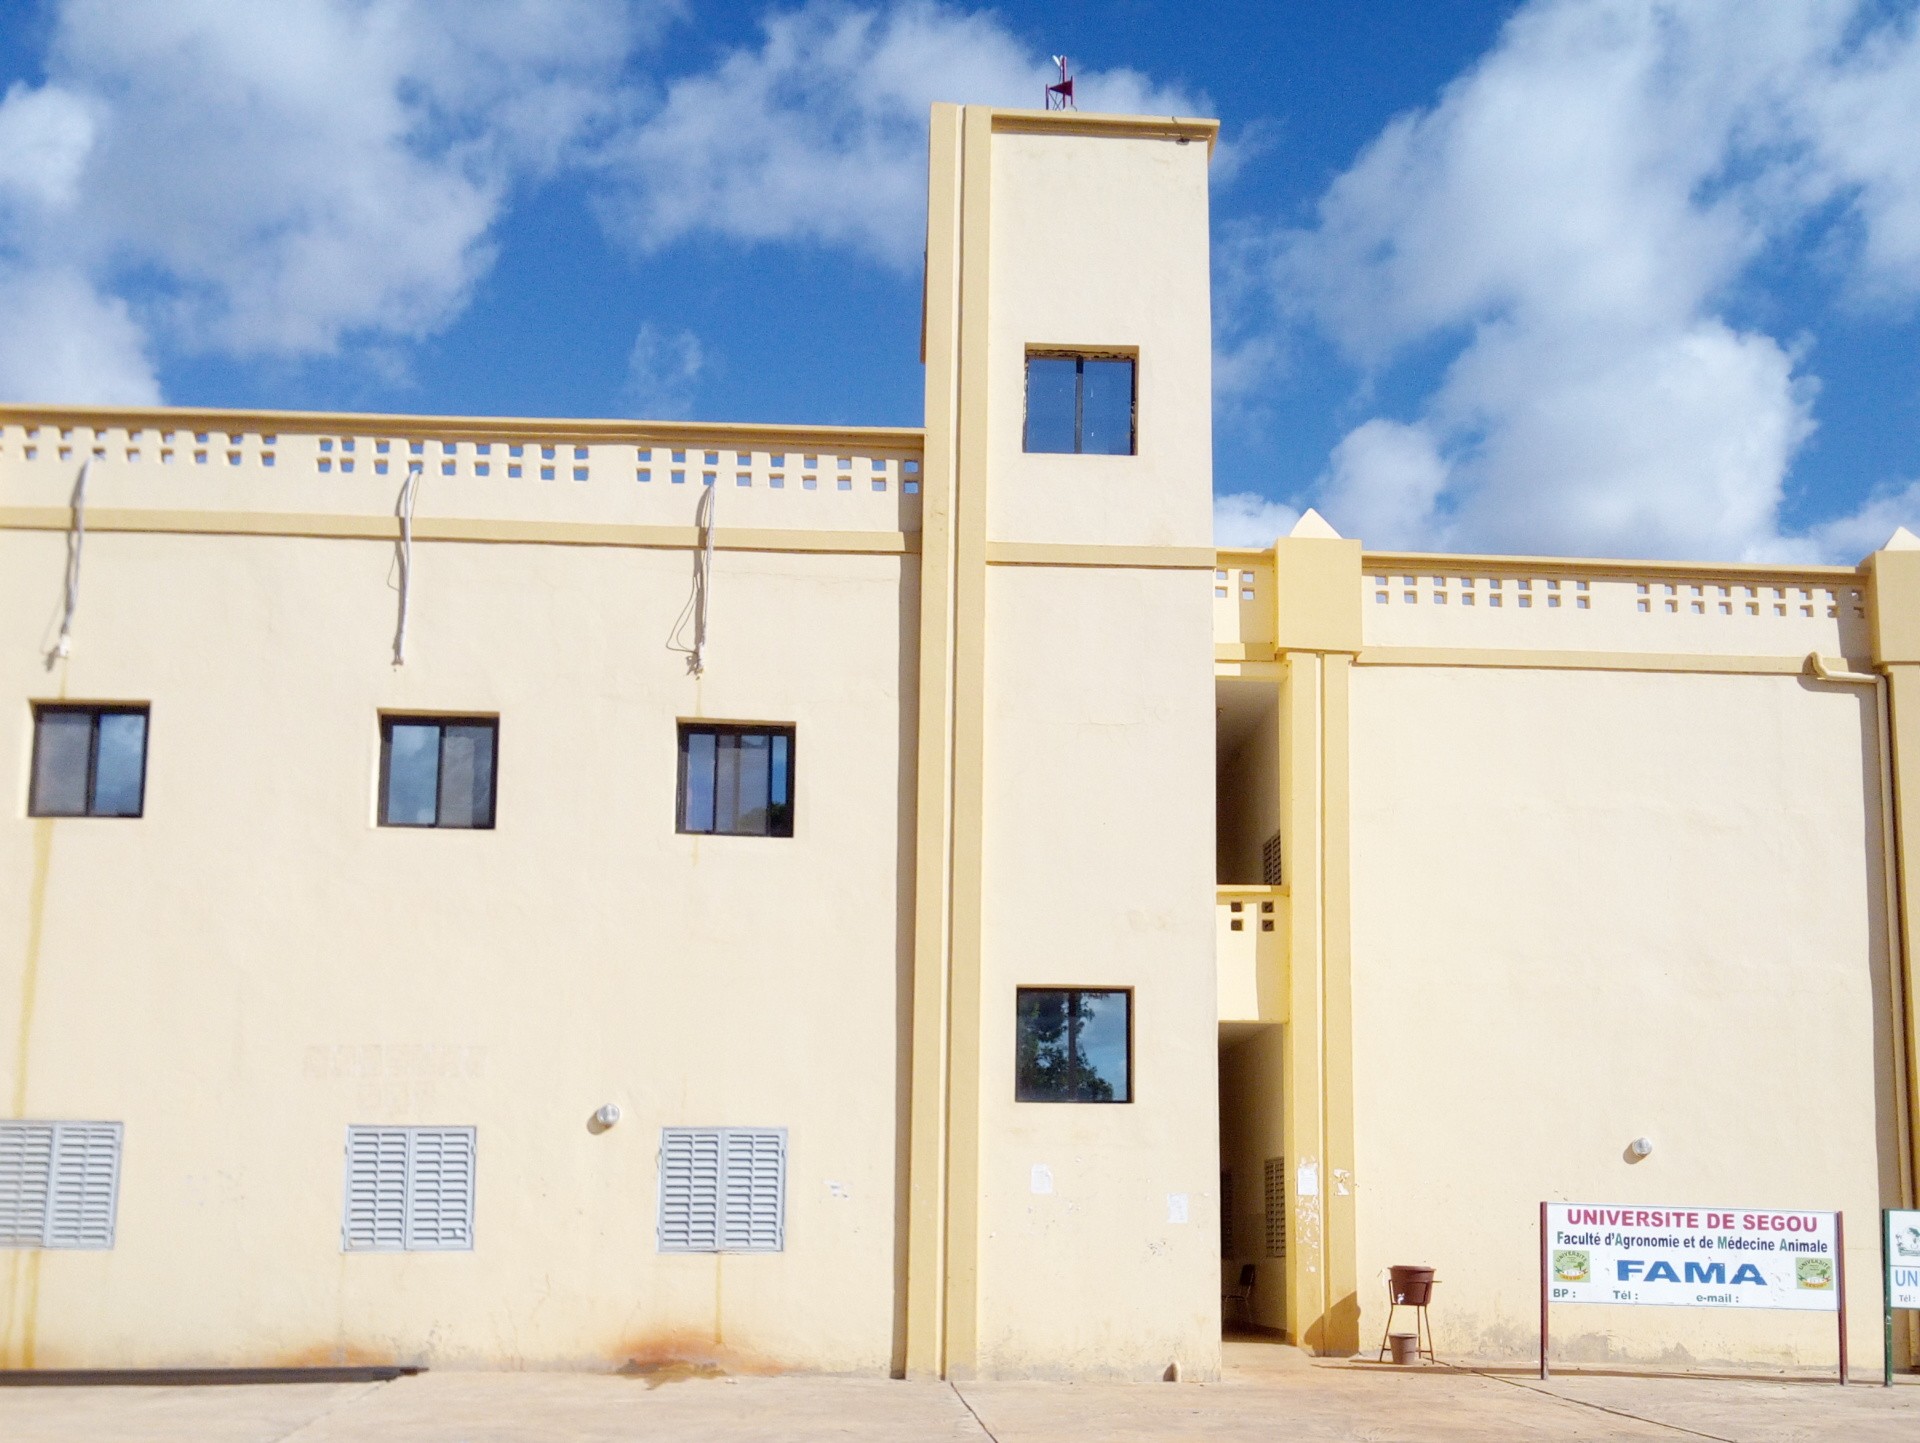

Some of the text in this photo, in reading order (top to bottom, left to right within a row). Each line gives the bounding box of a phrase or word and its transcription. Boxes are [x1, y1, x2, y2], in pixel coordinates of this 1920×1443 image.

[1567, 1208, 1818, 1233] UNIVERSITE DE SEGOU
[1557, 1231, 1828, 1253] Faculté d'Agronomie et de Médecine Animale
[1616, 1260, 1768, 1286] FAMA
[1696, 1293, 1732, 1304] e-mail
